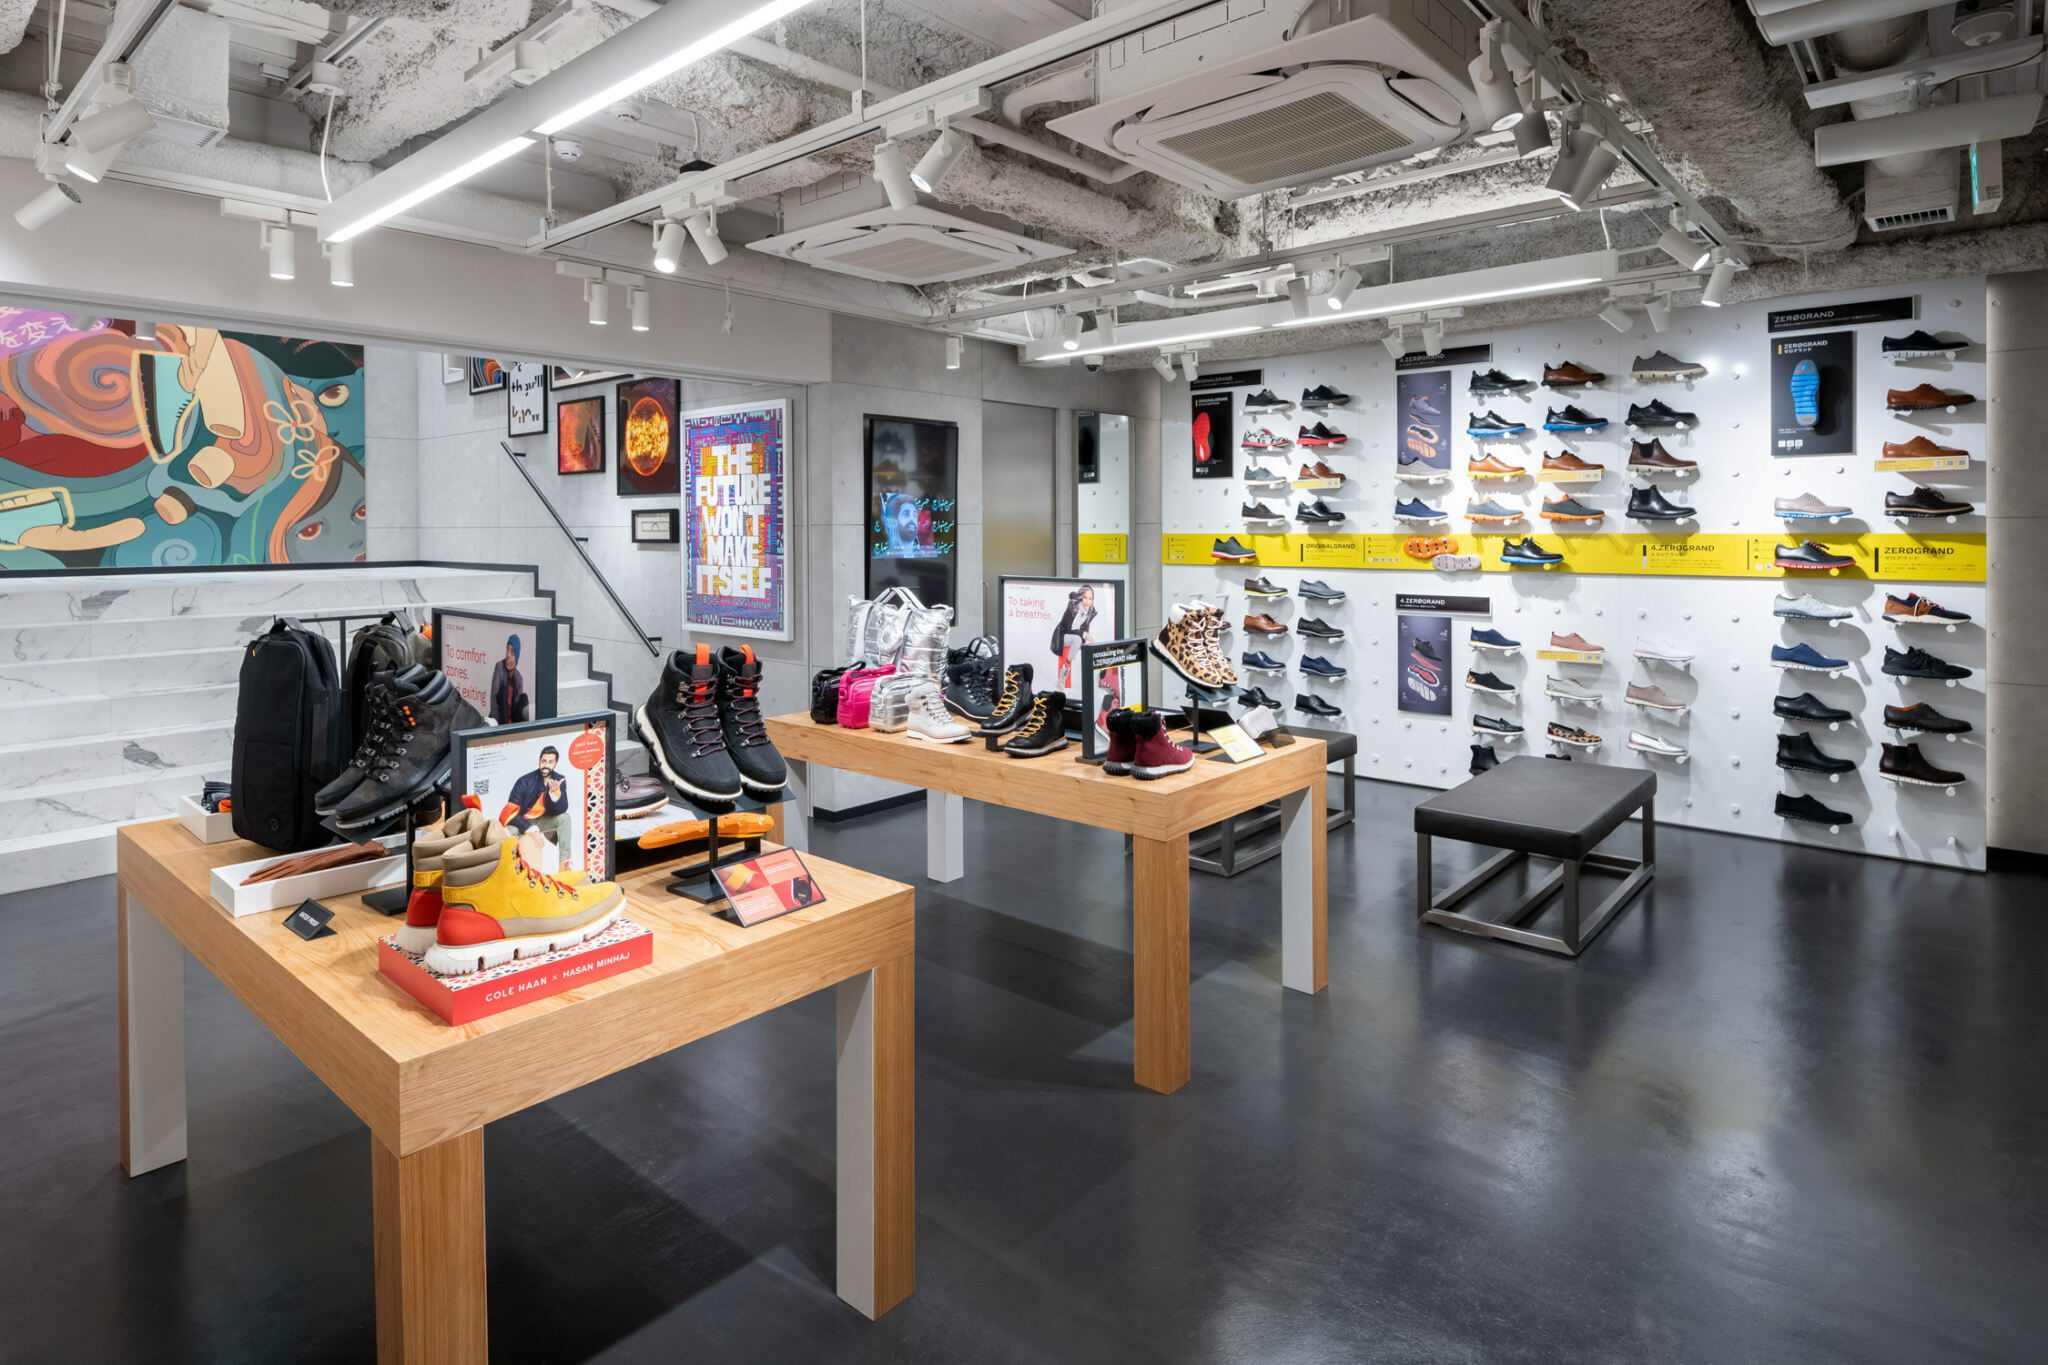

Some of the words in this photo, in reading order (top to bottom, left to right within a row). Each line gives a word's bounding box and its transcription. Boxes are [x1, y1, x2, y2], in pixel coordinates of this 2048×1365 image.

[711, 443, 753, 475] THE
[696, 473, 771, 507] FUTURE
[702, 504, 765, 536] WON'T
[707, 535, 760, 567] MAKE
[696, 565, 771, 599] ITSELF
[1008, 596, 1017, 606] To
[1020, 597, 1045, 610] taking
[446, 644, 454, 658] To
[456, 648, 487, 664] comfort
[446, 665, 469, 680] zones.
[462, 685, 487, 707] exiting
[485, 986, 515, 1002] COLE
[518, 977, 547, 993] HAAN
[562, 963, 594, 979] HASAN
[596, 952, 630, 969] MINHAJ
